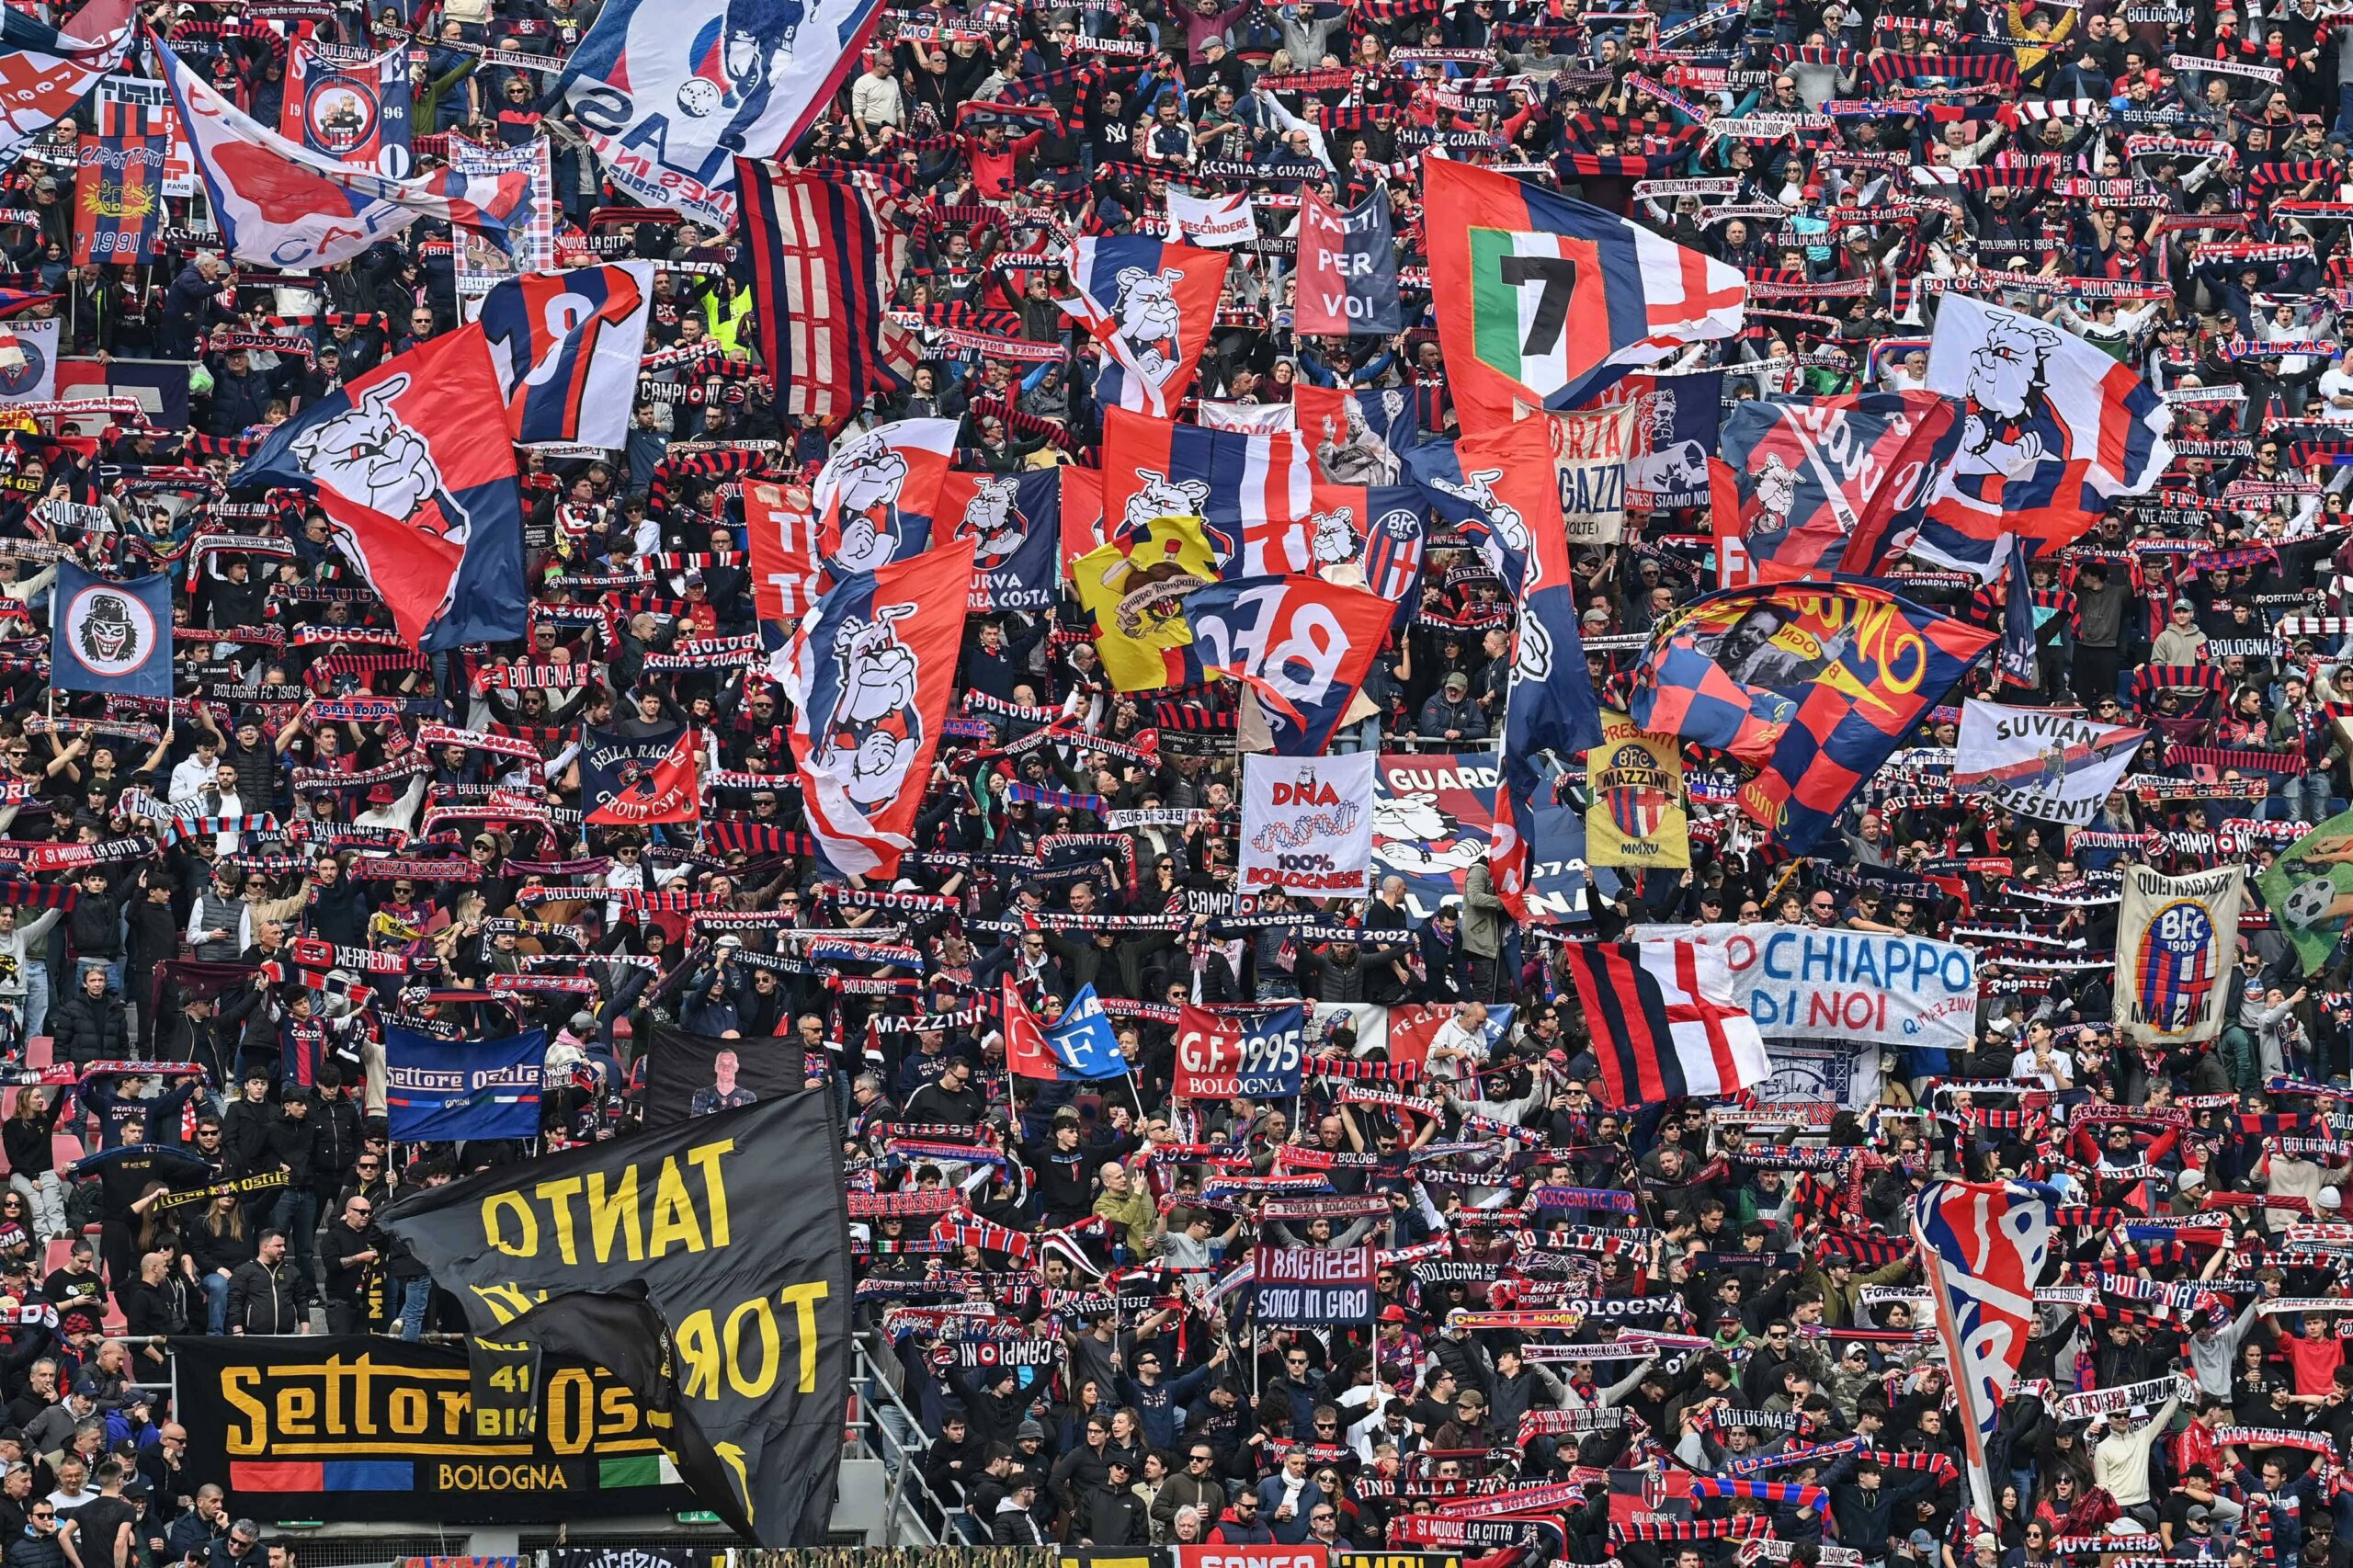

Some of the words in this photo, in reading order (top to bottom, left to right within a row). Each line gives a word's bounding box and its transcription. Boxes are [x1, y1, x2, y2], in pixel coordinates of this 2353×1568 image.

[2129, 9, 2182, 22] BOLOGNA
[520, 19, 534, 30] BFC
[783, 24, 793, 38] 8
[1893, 19, 1928, 31] ALLA
[319, 42, 368, 60] BOLOGNA
[1075, 37, 1134, 52] BOLOGNA
[1686, 71, 1696, 82] SI
[1698, 70, 1725, 83] MUOVE
[1728, 70, 1739, 83] LA
[1741, 68, 1765, 84] CITTÀ
[290, 104, 301, 118] 19
[384, 106, 404, 119] 96
[2124, 110, 2172, 121] BOLOGNA
[165, 112, 173, 156] 1995
[1763, 123, 1783, 135] 1909
[79, 143, 165, 168] CAPOTTATI
[1650, 181, 1686, 192] BOLOGNA
[1688, 180, 1699, 191] FC
[1700, 180, 1719, 191] 1909
[2077, 181, 2134, 195] BOLOGNA
[1204, 215, 1211, 225] A
[1309, 203, 1378, 230] FATTI
[91, 232, 140, 253] 1991
[1779, 233, 1827, 245] BOLOGNA
[1319, 251, 1371, 275] PER
[1925, 278, 1999, 290] BOLOGNA
[2083, 281, 2132, 296] BOLOGNA
[655, 304, 676, 317] BFC
[1324, 294, 1374, 317] VOI
[1500, 256, 1576, 355] 7
[11, 322, 51, 330] ELATO
[233, 335, 310, 348] BOLOGNA
[2231, 342, 2333, 356] ULTRAS
[2168, 390, 2204, 401] BOLOGNA
[1655, 492, 1691, 506] SIAMO
[1388, 515, 1415, 533] BFC
[2139, 509, 2156, 525] WE
[2160, 510, 2178, 525] ARE
[2182, 512, 2204, 527] ONE
[556, 576, 576, 585] ANNI
[1910, 578, 1950, 586] GUARDIA
[1000, 590, 1049, 605] COSTA
[1120, 589, 1154, 614] Gruppo
[2209, 639, 2268, 657] BOLOGNA
[2271, 639, 2282, 650] FC
[509, 665, 573, 687] BOLOGNA
[576, 665, 585, 677] FC
[214, 685, 259, 698] BOLOGNA
[262, 686, 273, 698] FC
[317, 702, 351, 715] FORZA
[975, 694, 1051, 722] BOLOGNA
[1005, 733, 1042, 754] BOLOGNA
[1071, 732, 1126, 756] BOLOGNA
[1996, 715, 2116, 763] SUVIANA
[590, 747, 633, 771] BELLA
[1618, 751, 1648, 766] BFC
[345, 777, 364, 786] ANNI
[1604, 771, 1668, 788] MAZZINI
[1274, 780, 1339, 804] DNA
[1975, 775, 2102, 821] PRESENTE
[597, 790, 646, 817] GROUP
[652, 789, 684, 813] CSPT
[1621, 844, 1659, 855] MMXV
[2073, 834, 2120, 849] BOLOGNA
[45, 848, 54, 861] SI
[56, 846, 92, 862] MUOVE
[921, 853, 968, 865] 2002
[369, 860, 406, 874] FORZA
[410, 860, 465, 875] BOLOGNA
[1278, 855, 1334, 871] 100%
[1248, 869, 1363, 889] BOLOGNESE
[2138, 872, 2170, 896] QUEI
[2173, 872, 2229, 896] RAGAZZI
[545, 890, 609, 901] BOLOGNA
[838, 891, 943, 911] BOLOGNA
[704, 920, 779, 928] BOLOGNA
[1222, 915, 1315, 927] BOLOGNA
[2160, 905, 2205, 939] BFC
[1303, 926, 1356, 940] BUCCE
[1361, 929, 1408, 940] 2002
[2166, 940, 2196, 950] 1909
[1763, 934, 1970, 987] CHIAPPO
[844, 980, 886, 994] BOLOGNA
[1988, 979, 2052, 994] Ragazzi
[1752, 990, 1796, 1025] DI
[1810, 990, 1884, 1028] NOI
[1904, 1017, 1921, 1035] Q.
[1916, 999, 1976, 1027] MAZZINI
[2131, 1001, 2211, 1023] MAZZINI
[876, 1010, 982, 1033] MAZZINI
[1216, 1019, 1265, 1032] XXV
[1392, 1020, 1413, 1038] TE
[1414, 1012, 1434, 1028] CE
[292, 1029, 322, 1039] CAZOO
[1180, 1033, 1227, 1074] G.F.
[1234, 1031, 1300, 1074] 1995
[386, 1068, 462, 1088] Settore
[472, 1063, 539, 1089] Ostile
[546, 1063, 573, 1075] PADRE
[1188, 1078, 1285, 1094] BOLOGNA
[923, 1124, 972, 1138] 1995
[2282, 1137, 2336, 1153] BOLOGNA
[1739, 1155, 1785, 1169] MORTE
[242, 1172, 290, 1189] Ostile
[848, 1194, 887, 1212] FORZA
[1538, 1189, 1586, 1205] BOLOGNA
[1282, 1203, 1319, 1214] FORZA
[1324, 1202, 1371, 1211] BOLOGNA
[1548, 1234, 1604, 1249] ALLA
[1261, 1250, 1268, 1278] I
[1274, 1248, 1368, 1278] RAGAZZI
[2263, 1254, 2314, 1267] ALLA
[1418, 1265, 1482, 1282] BOLOGNA
[1867, 1289, 1921, 1298] FOREVER
[2045, 1288, 2057, 1301] FC
[2062, 1288, 2083, 1301] 1909
[1258, 1290, 1300, 1317] SONO
[1304, 1290, 1324, 1317] IN
[1330, 1290, 1367, 1318] GIRO
[889, 1312, 932, 1334] Bologna
[1534, 1311, 1578, 1323] BOLOGNA
[1553, 1347, 1585, 1356] FORZA
[1588, 1344, 1631, 1356] BOLOGNA
[490, 1366, 529, 1392] 41
[221, 1353, 470, 1454] Settor
[477, 1409, 536, 1435] BIS
[1719, 1411, 1781, 1426] BOLOGNA
[1785, 1414, 1796, 1424] FC
[2250, 1429, 2285, 1445] FORZA
[1735, 1440, 1853, 1472] ULTRAS
[438, 1464, 568, 1491] BOLOGNA
[1354, 1478, 1394, 1496] FINO
[1415, 1480, 1454, 1495] ALLA
[1632, 1511, 1665, 1523] BOLOGNA
[1668, 1512, 1676, 1522] FC
[1416, 1521, 1427, 1534] SI
[1428, 1520, 1462, 1538] MUOVE
[1467, 1521, 1478, 1539] LA
[1481, 1519, 1512, 1540] CITTÀ
